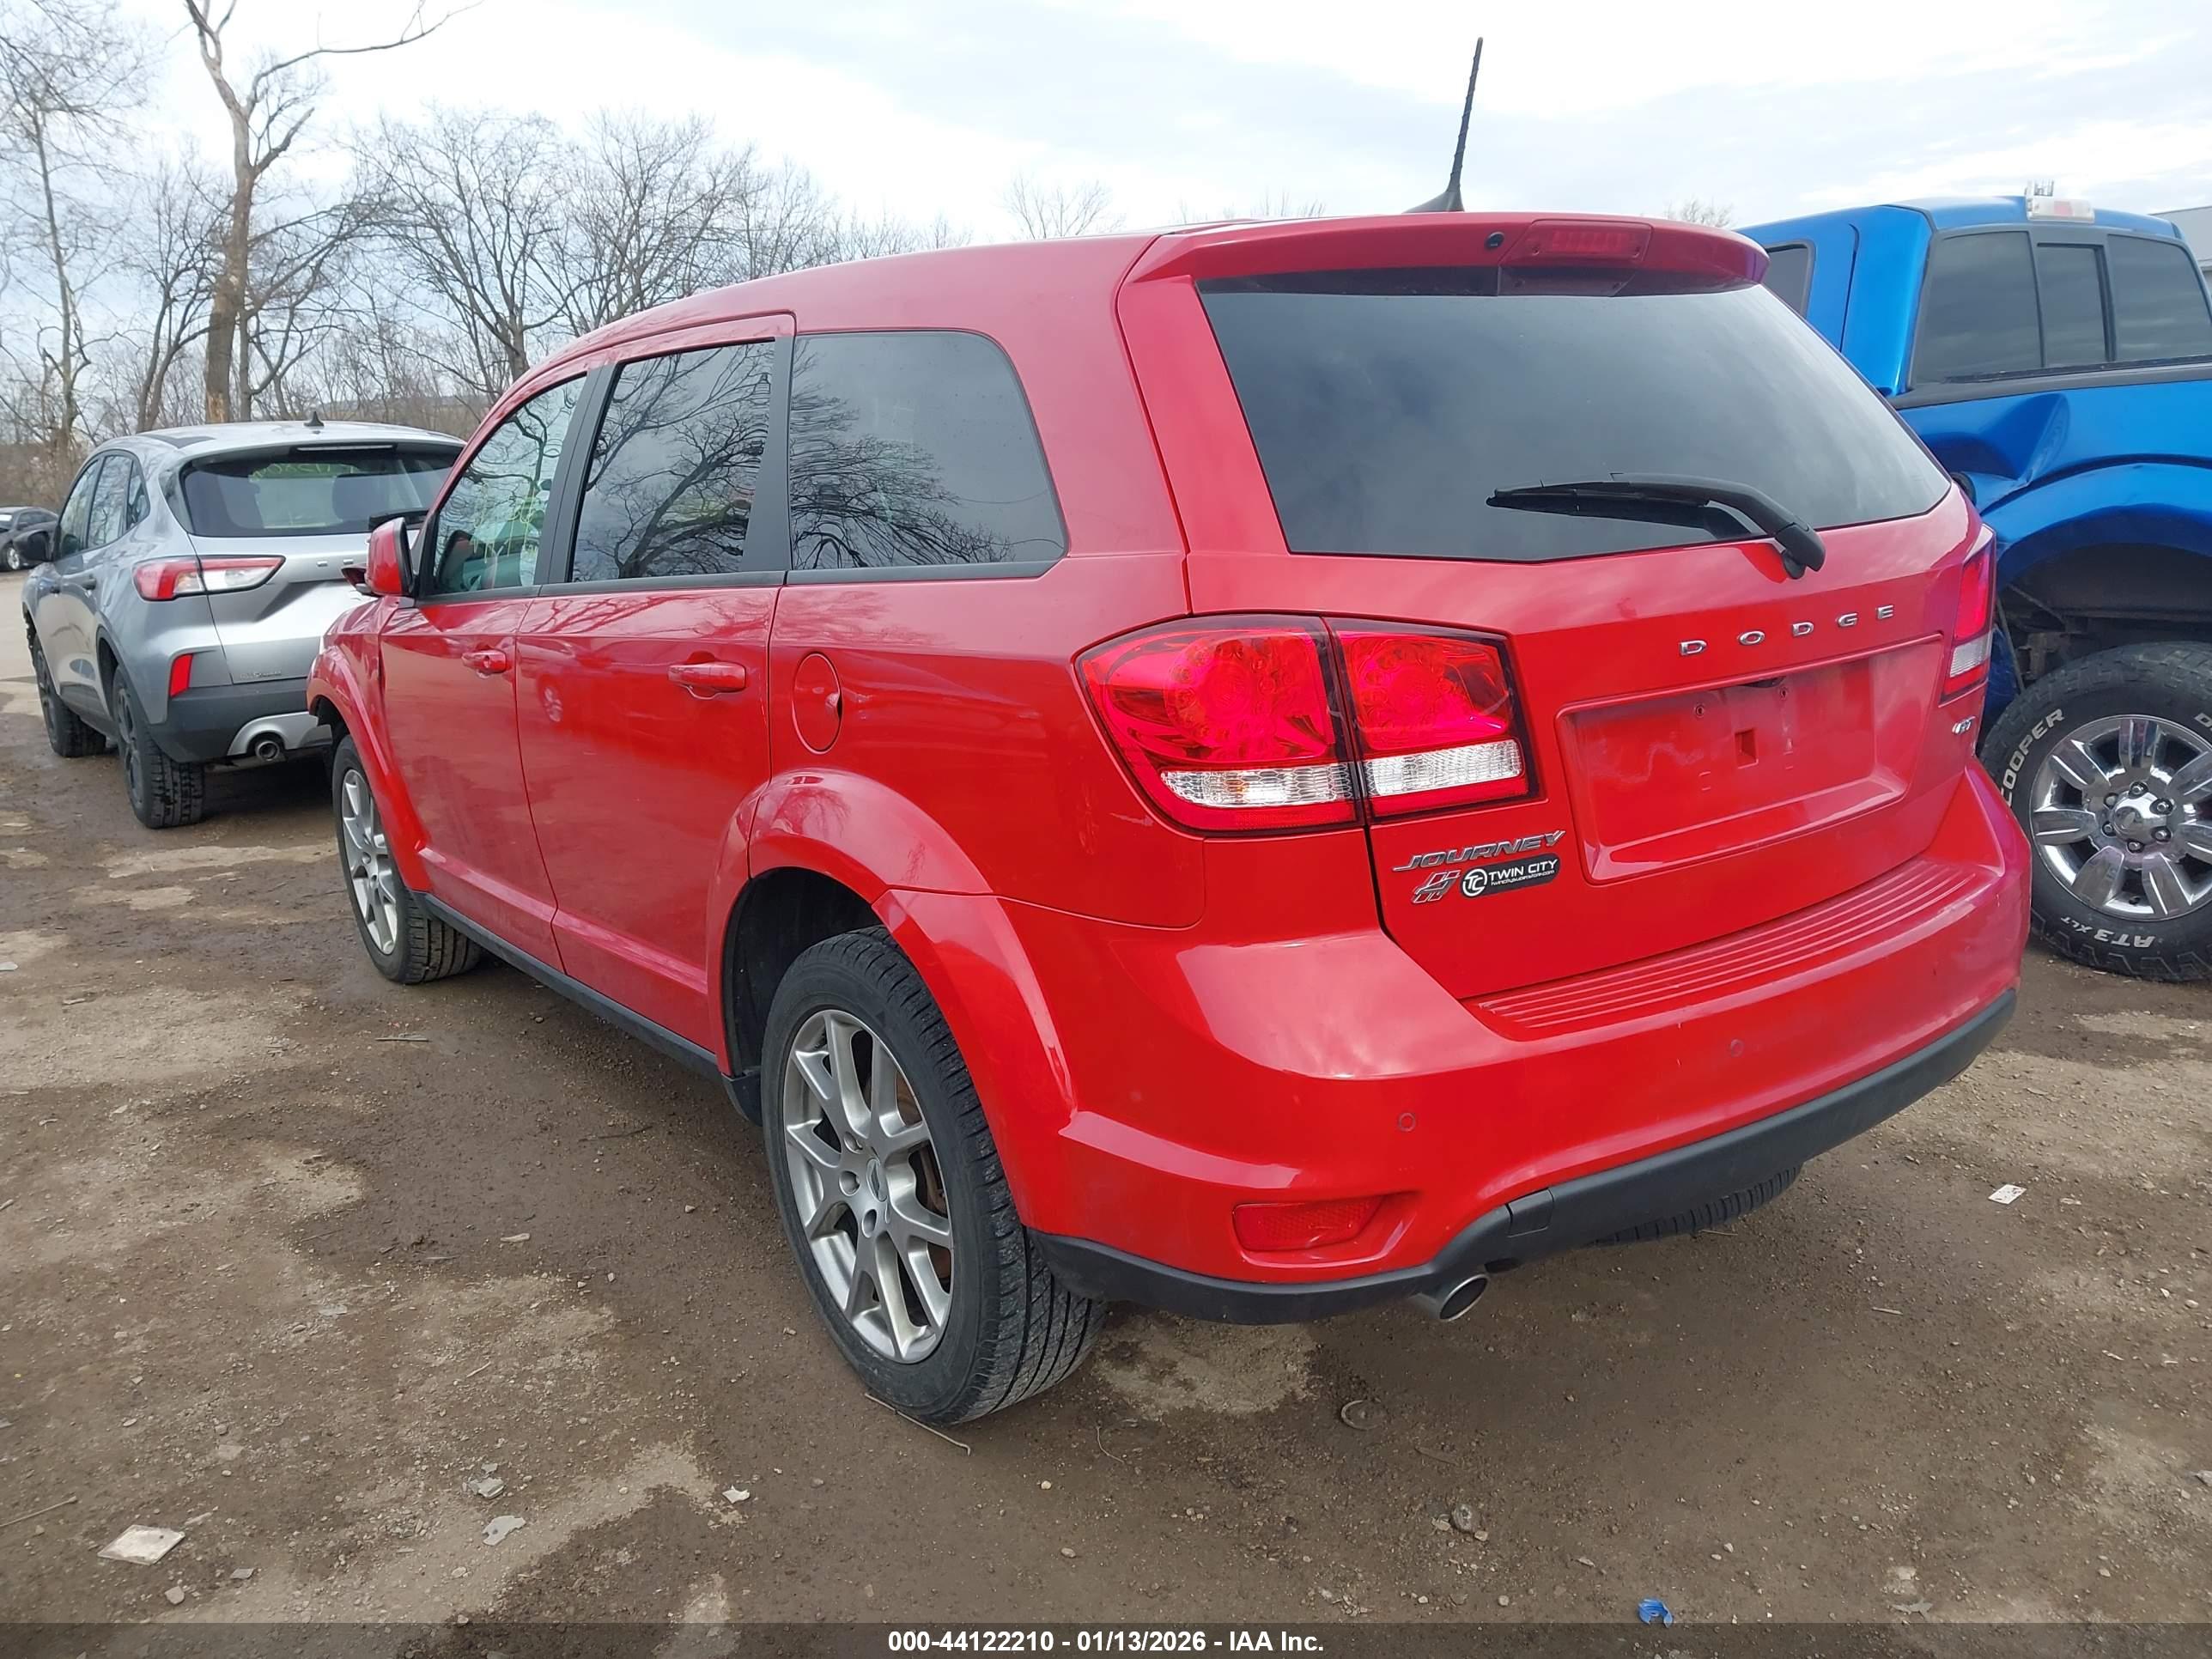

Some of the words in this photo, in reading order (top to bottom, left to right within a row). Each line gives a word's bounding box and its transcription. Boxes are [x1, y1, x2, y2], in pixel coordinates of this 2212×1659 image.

[1680, 605, 1894, 656] DODGE
[1392, 830, 1565, 872] JOURNEY
[1488, 866, 1524, 881] TWIN
[1528, 859, 1558, 874] CITY
[2094, 928, 2155, 948] AT3
